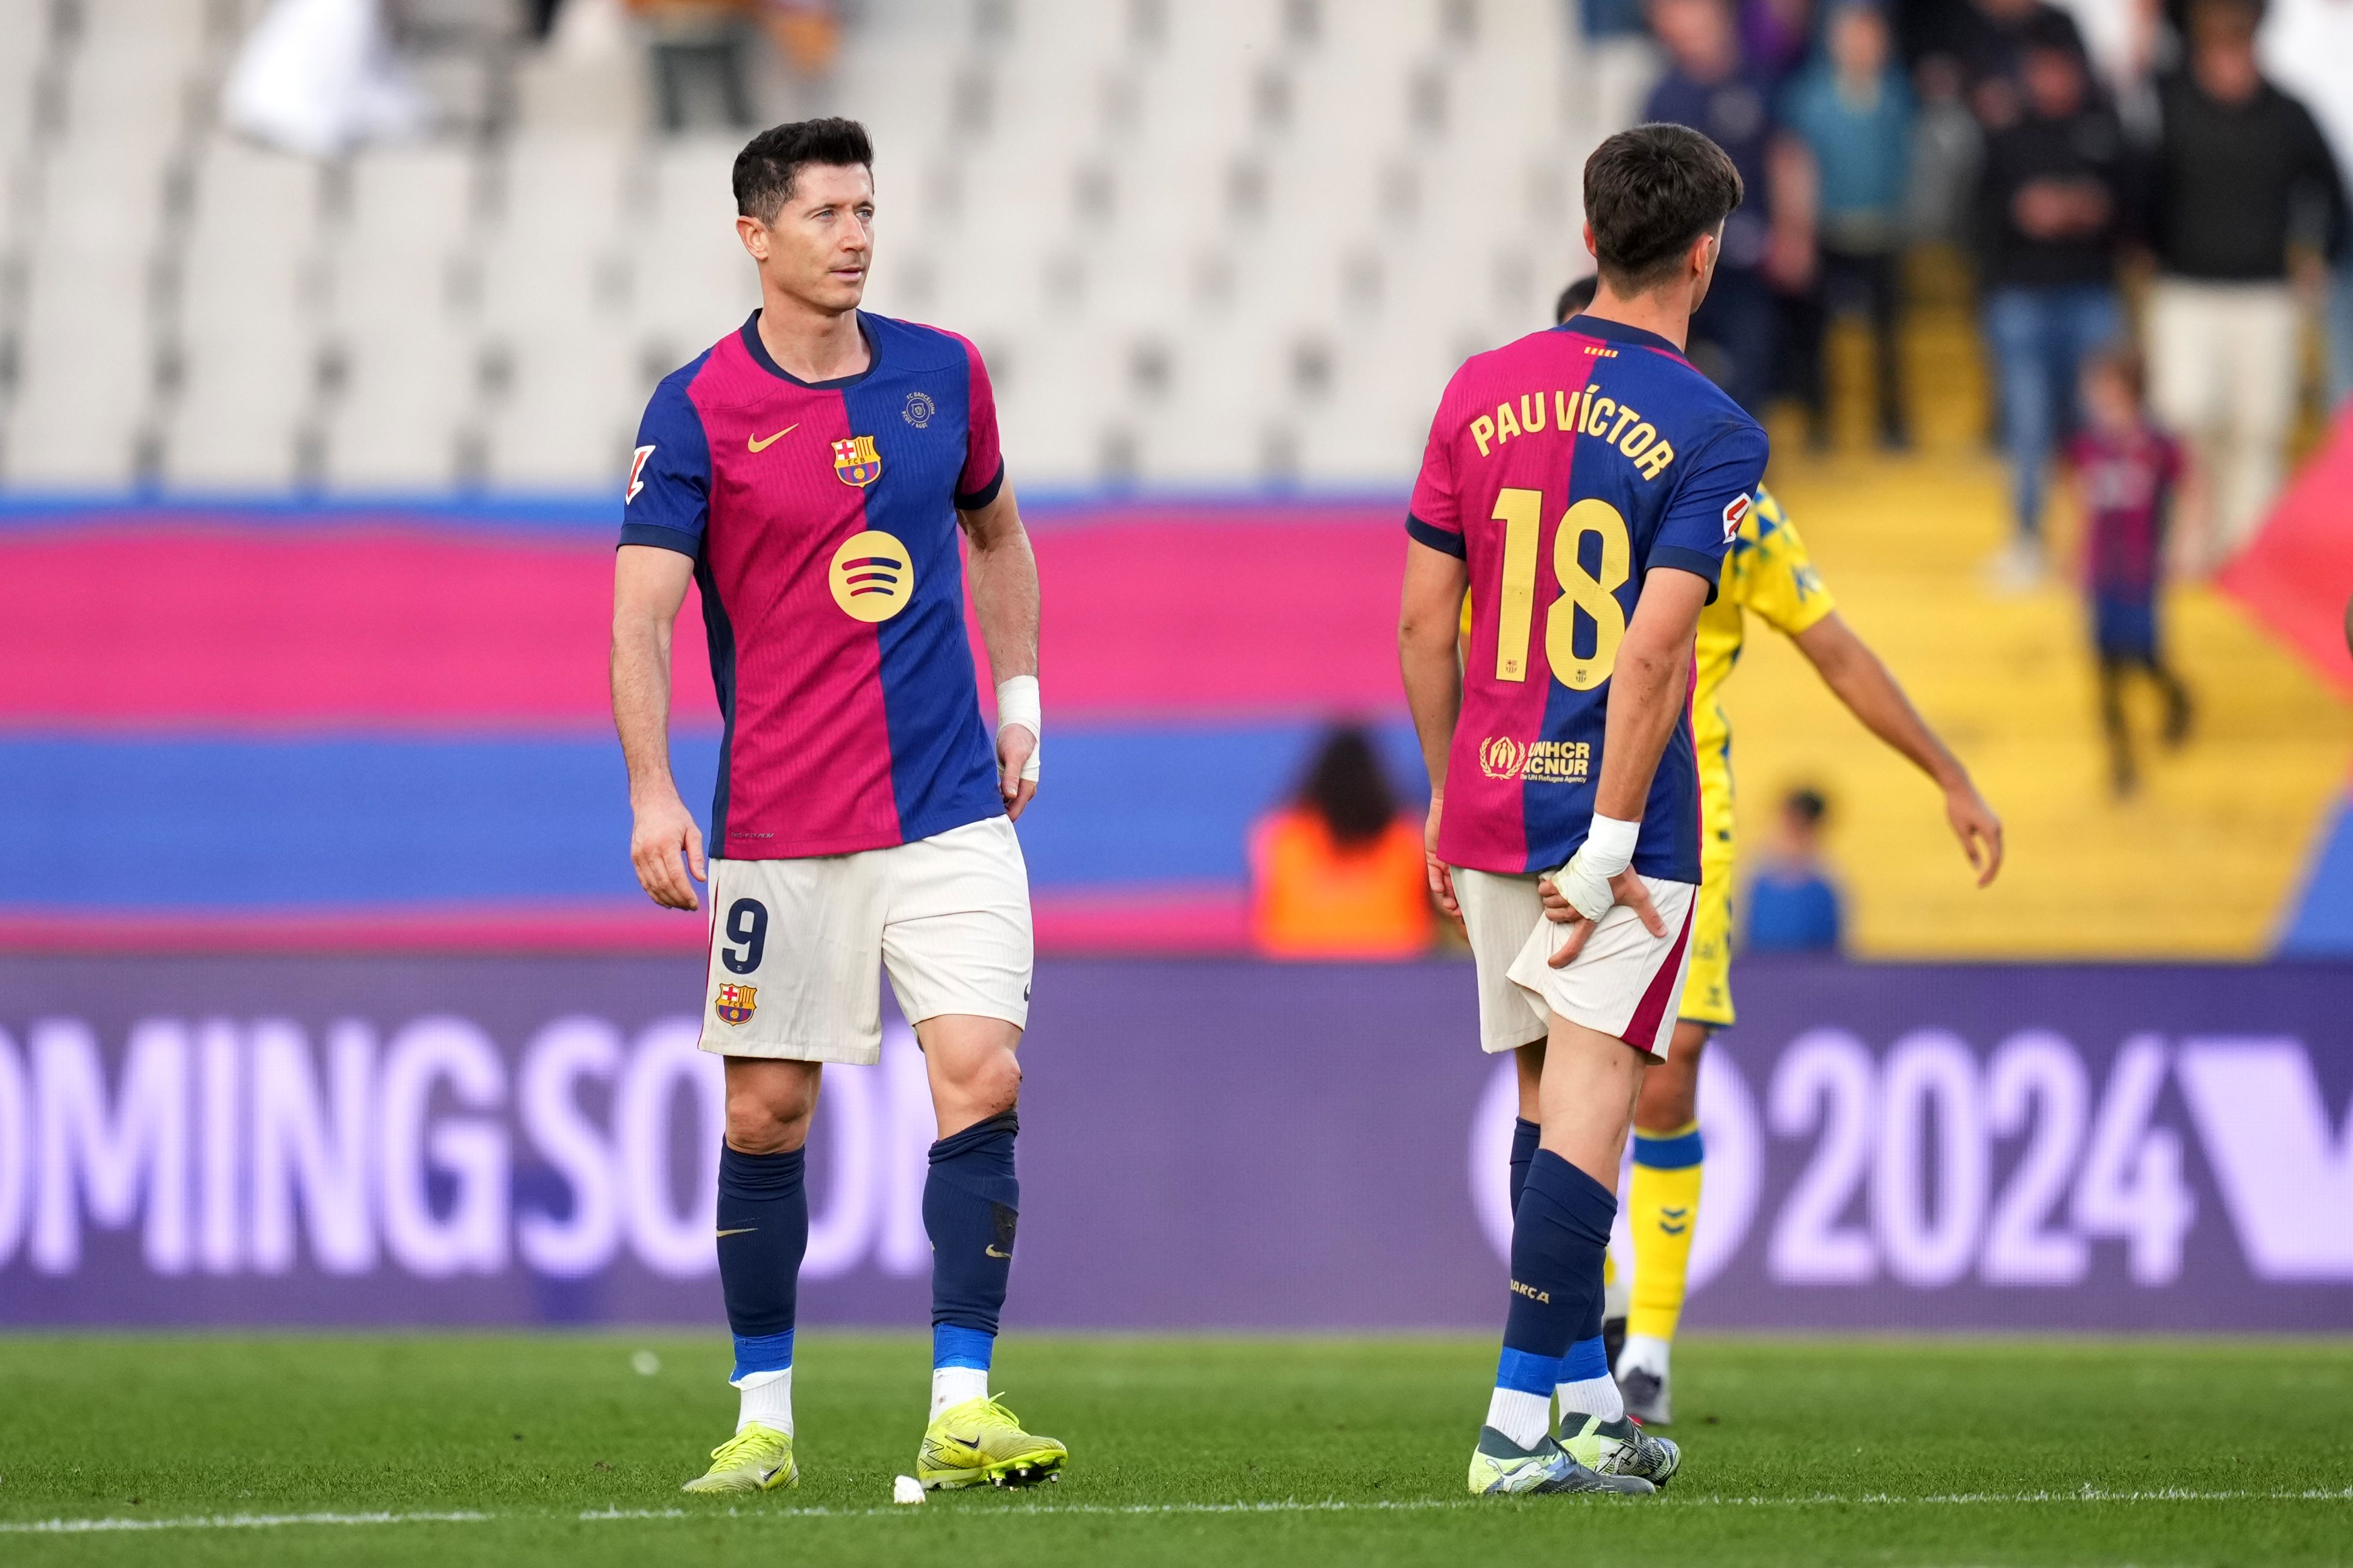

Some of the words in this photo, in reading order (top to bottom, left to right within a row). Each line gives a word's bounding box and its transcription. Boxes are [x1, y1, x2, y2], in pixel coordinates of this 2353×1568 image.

[914, 392, 935, 415] BARCELONA
[1469, 391, 1547, 457] PAU
[1555, 383, 1674, 481] VÍCTOR
[1491, 488, 1630, 691] 18
[1521, 757, 1588, 776] ACNUR
[1528, 741, 1590, 759] UNHCR
[1538, 774, 1563, 783] Refugee
[722, 898, 768, 974] 9
[1766, 1027, 2195, 1288] 2024
